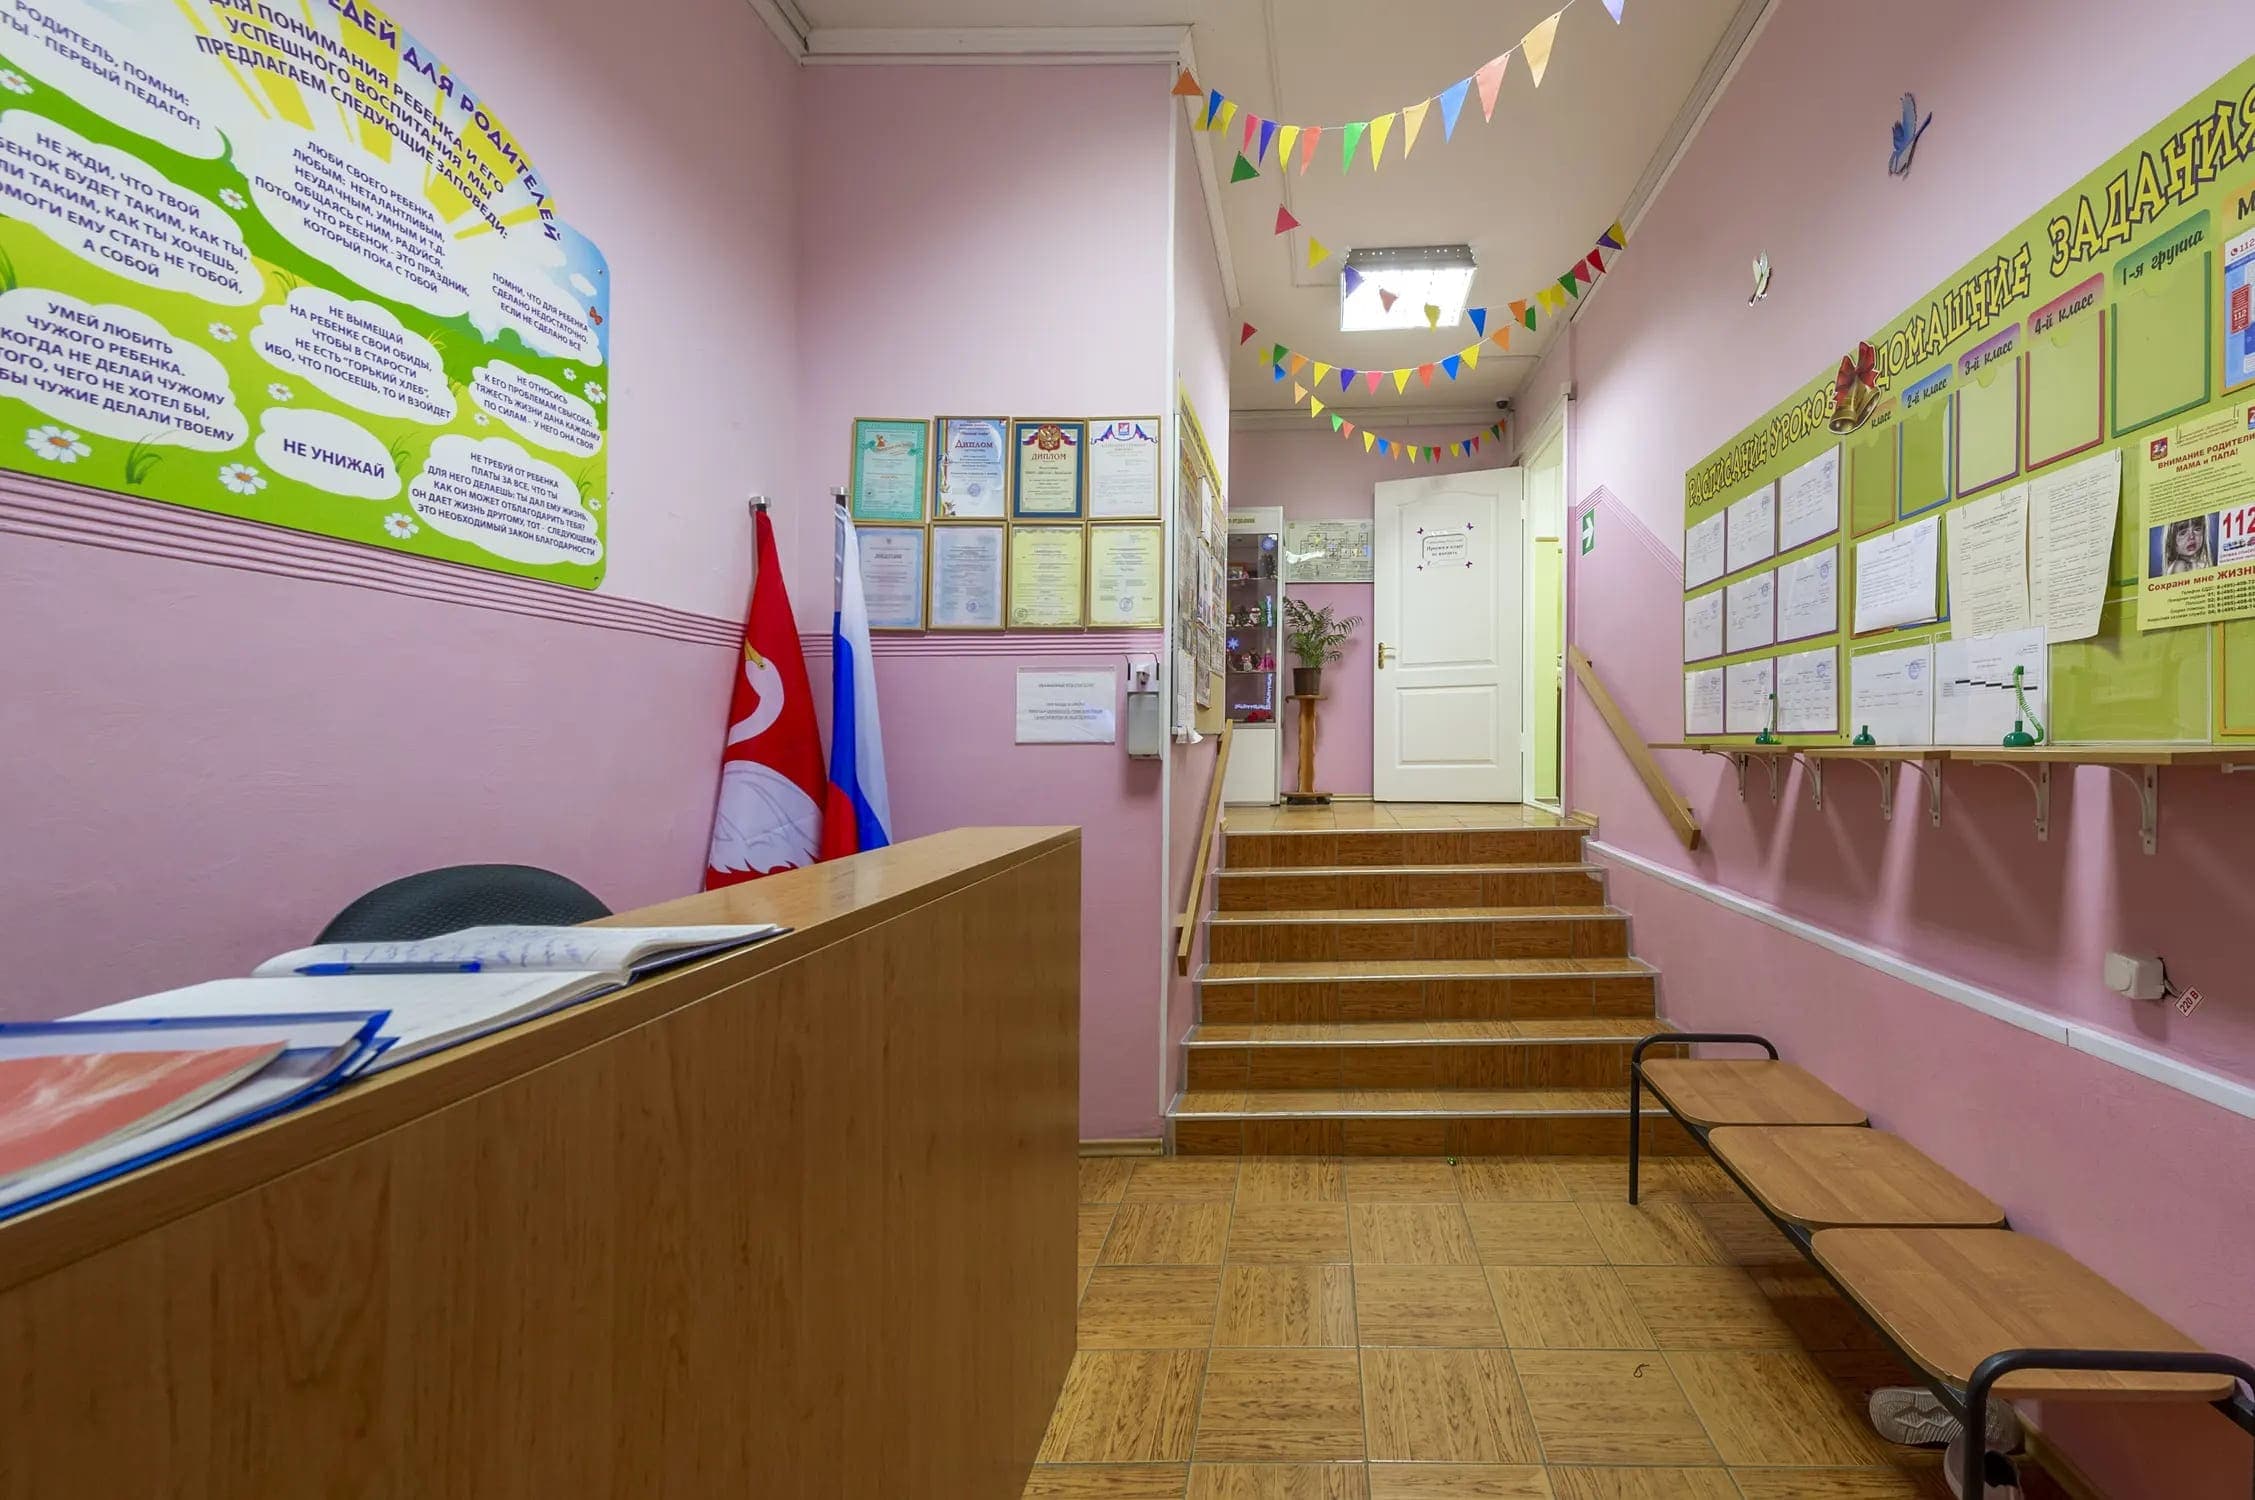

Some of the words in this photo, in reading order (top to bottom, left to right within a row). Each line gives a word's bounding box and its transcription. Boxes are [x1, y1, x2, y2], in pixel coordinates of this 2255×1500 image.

[44, 35, 120, 85] ПЕРВЫЙ
[225, 16, 351, 84] УСПЕШНОГО
[355, 78, 462, 169] ВОСПИТАНИЯ
[467, 171, 492, 201] МЫ
[257, 3, 389, 89] ПОНИМАНИЯ
[393, 83, 463, 151] РЕБЕНКА
[466, 149, 478, 165] И
[479, 162, 505, 193] ЕГО
[195, 34, 327, 94] ПРЕДЛАГАЕМ
[330, 86, 434, 165] СЛЕДУЮЩИЕ
[435, 159, 509, 240] ЗАПОВЕДИ:
[402, 46, 455, 98] ДЛЯ
[460, 94, 561, 242] РОДИТЕЛЕЙ
[36, 132, 61, 154] НЕ
[119, 172, 153, 196] ЧТО
[156, 189, 199, 218] ТВОЙ
[307, 140, 344, 168] ЛЮБИ
[345, 163, 388, 194] СВОЕГО
[390, 189, 434, 222] РЕБЕНКА
[64, 166, 120, 200] БУДЕТ
[189, 224, 219, 246] КАК
[255, 175, 310, 210] ПОТОМУ
[312, 206, 337, 225] ЧТО
[338, 219, 388, 253] РЕБЕНОК
[395, 250, 416, 267] ЭТО
[293, 181, 354, 219] ОБЩАЯСЬ
[66, 209, 105, 233] ЕМУ
[108, 228, 160, 258] СТАТЬ
[163, 251, 184, 269] НЕ
[105, 205, 139, 230] КАК
[142, 222, 167, 242] ТЫ
[376, 210, 417, 240] УМНЫМ
[82, 238, 95, 252] А
[99, 245, 159, 277] СОБОЙ
[303, 217, 361, 253] КОТОРЫЙ
[363, 247, 393, 271] ПОКА
[403, 268, 437, 293] ТОБОЙ
[2151, 229, 2204, 271] группа
[491, 285, 530, 311] СДЕЛАНО
[1876, 242, 2031, 390] ДОМАШНИЕ
[2034, 313, 2053, 335] 4-й
[2058, 293, 2094, 323] класс
[26, 314, 105, 349] ЧУЖОГО
[47, 302, 99, 329] УМЕЙ
[102, 321, 173, 354] ЛЮБИТЬ
[290, 303, 307, 319] НА
[309, 312, 359, 340] РЕБЕНКЕ
[361, 334, 390, 353] СВОИ
[328, 304, 344, 319] НЕ
[345, 312, 403, 344] ВЫМЕЩАЙ
[500, 301, 521, 319] ЕСЛИ
[532, 320, 568, 344] СДЕЛАНО
[558, 309, 588, 332] РЕБЕНКА
[0, 326, 63, 356] КОГДА
[68, 348, 91, 365] НЕ
[95, 357, 153, 384] ДЕЛАЙ
[157, 376, 225, 405] ЧУЖОМУ
[295, 337, 311, 351] НЕ
[313, 344, 342, 363] ЕСТЬ
[311, 328, 352, 352] ЧТОБЫ
[363, 350, 416, 378] СТАРОСТИ
[1964, 357, 1980, 376] 3-й
[53, 362, 98, 385] ЧЕГО
[102, 377, 124, 394] НЕ
[128, 385, 179, 410] ХОТЕЛ
[297, 353, 322, 370] ЧТО
[382, 385, 396, 398] ТО
[407, 395, 451, 418] ВЗОЙДЕТ
[475, 382, 513, 404] ТЯЖЕСТЬ
[491, 376, 507, 389] ЕГО
[507, 383, 557, 411] ПРОБЛЕМАМ
[516, 375, 527, 386] НЕ
[527, 380, 568, 404] ОТНОСИСЬ
[33, 377, 98, 405] ЧУЖИЕ
[102, 397, 170, 425] ДЕЛАЛИ
[173, 416, 234, 441] ТВОЕМУ
[483, 399, 497, 411] ПО
[497, 405, 527, 423] СИЛАМ
[539, 421, 559, 436] НЕГО
[283, 438, 306, 457] НЕ
[310, 446, 384, 479] УНИЖАЙ
[1688, 430, 1768, 508] РАСПИСАНИЕ
[1770, 381, 1836, 458] УРОКОВ
[2158, 449, 2205, 469] ВНИМАНИЕ
[427, 464, 447, 478] ДЛЯ
[448, 471, 472, 485] НЕГО
[470, 451, 482, 463] НЕ
[482, 455, 513, 473] ТРЕБУЙ
[526, 470, 558, 488] РЕБЕНКА
[470, 465, 500, 481] ПЛАТЫ
[2176, 460, 2201, 472] МАМА
[411, 487, 426, 499] ОН
[427, 492, 452, 506] ДАЕТ
[453, 498, 485, 515] ЖИЗНЬ
[433, 479, 452, 493] КАК
[468, 490, 500, 506] МОЖЕТ
[500, 499, 565, 525] ОТБЛАГОДАРИТЬ
[417, 503, 437, 515] ЭТО
[437, 508, 507, 533] НЕОБХОДИМЫЙ
[507, 526, 534, 540] ЗАКОН
[534, 534, 595, 556] БЛАГОДАРНОСТИ
[2222, 506, 2255, 539] 112
[2148, 579, 2190, 592] Сохрани
[2193, 575, 2215, 585] мне
